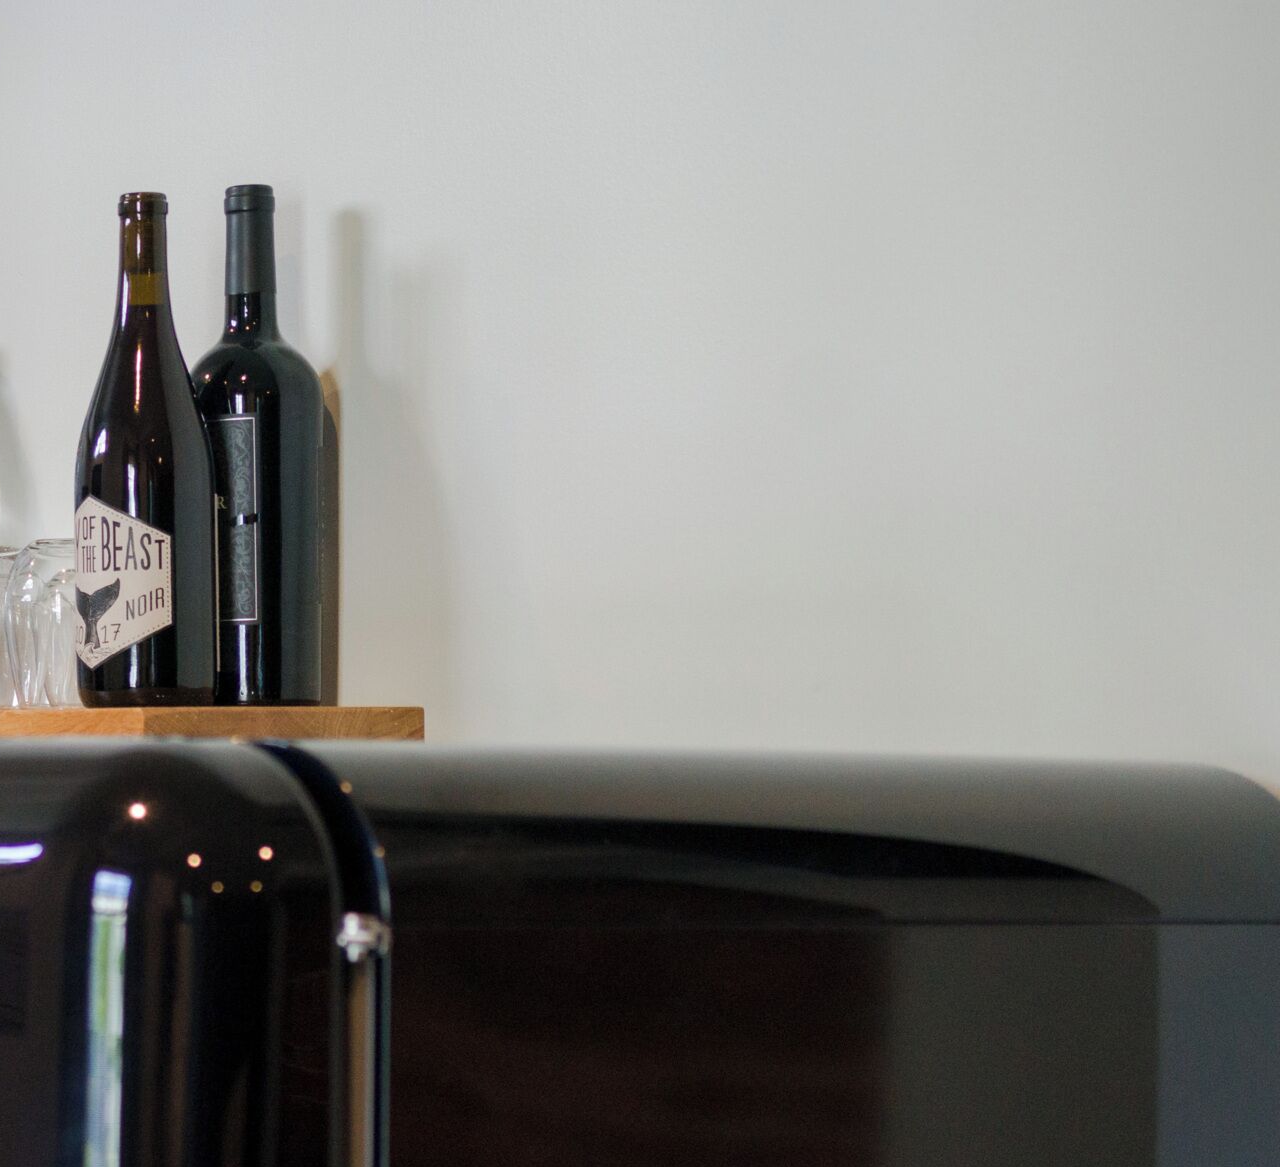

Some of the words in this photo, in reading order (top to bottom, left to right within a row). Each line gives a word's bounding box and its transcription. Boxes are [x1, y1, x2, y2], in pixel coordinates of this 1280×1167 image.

[82, 515, 97, 541] OF
[101, 515, 166, 572] BEAST
[81, 545, 97, 574] THE
[125, 587, 166, 621] NOIR
